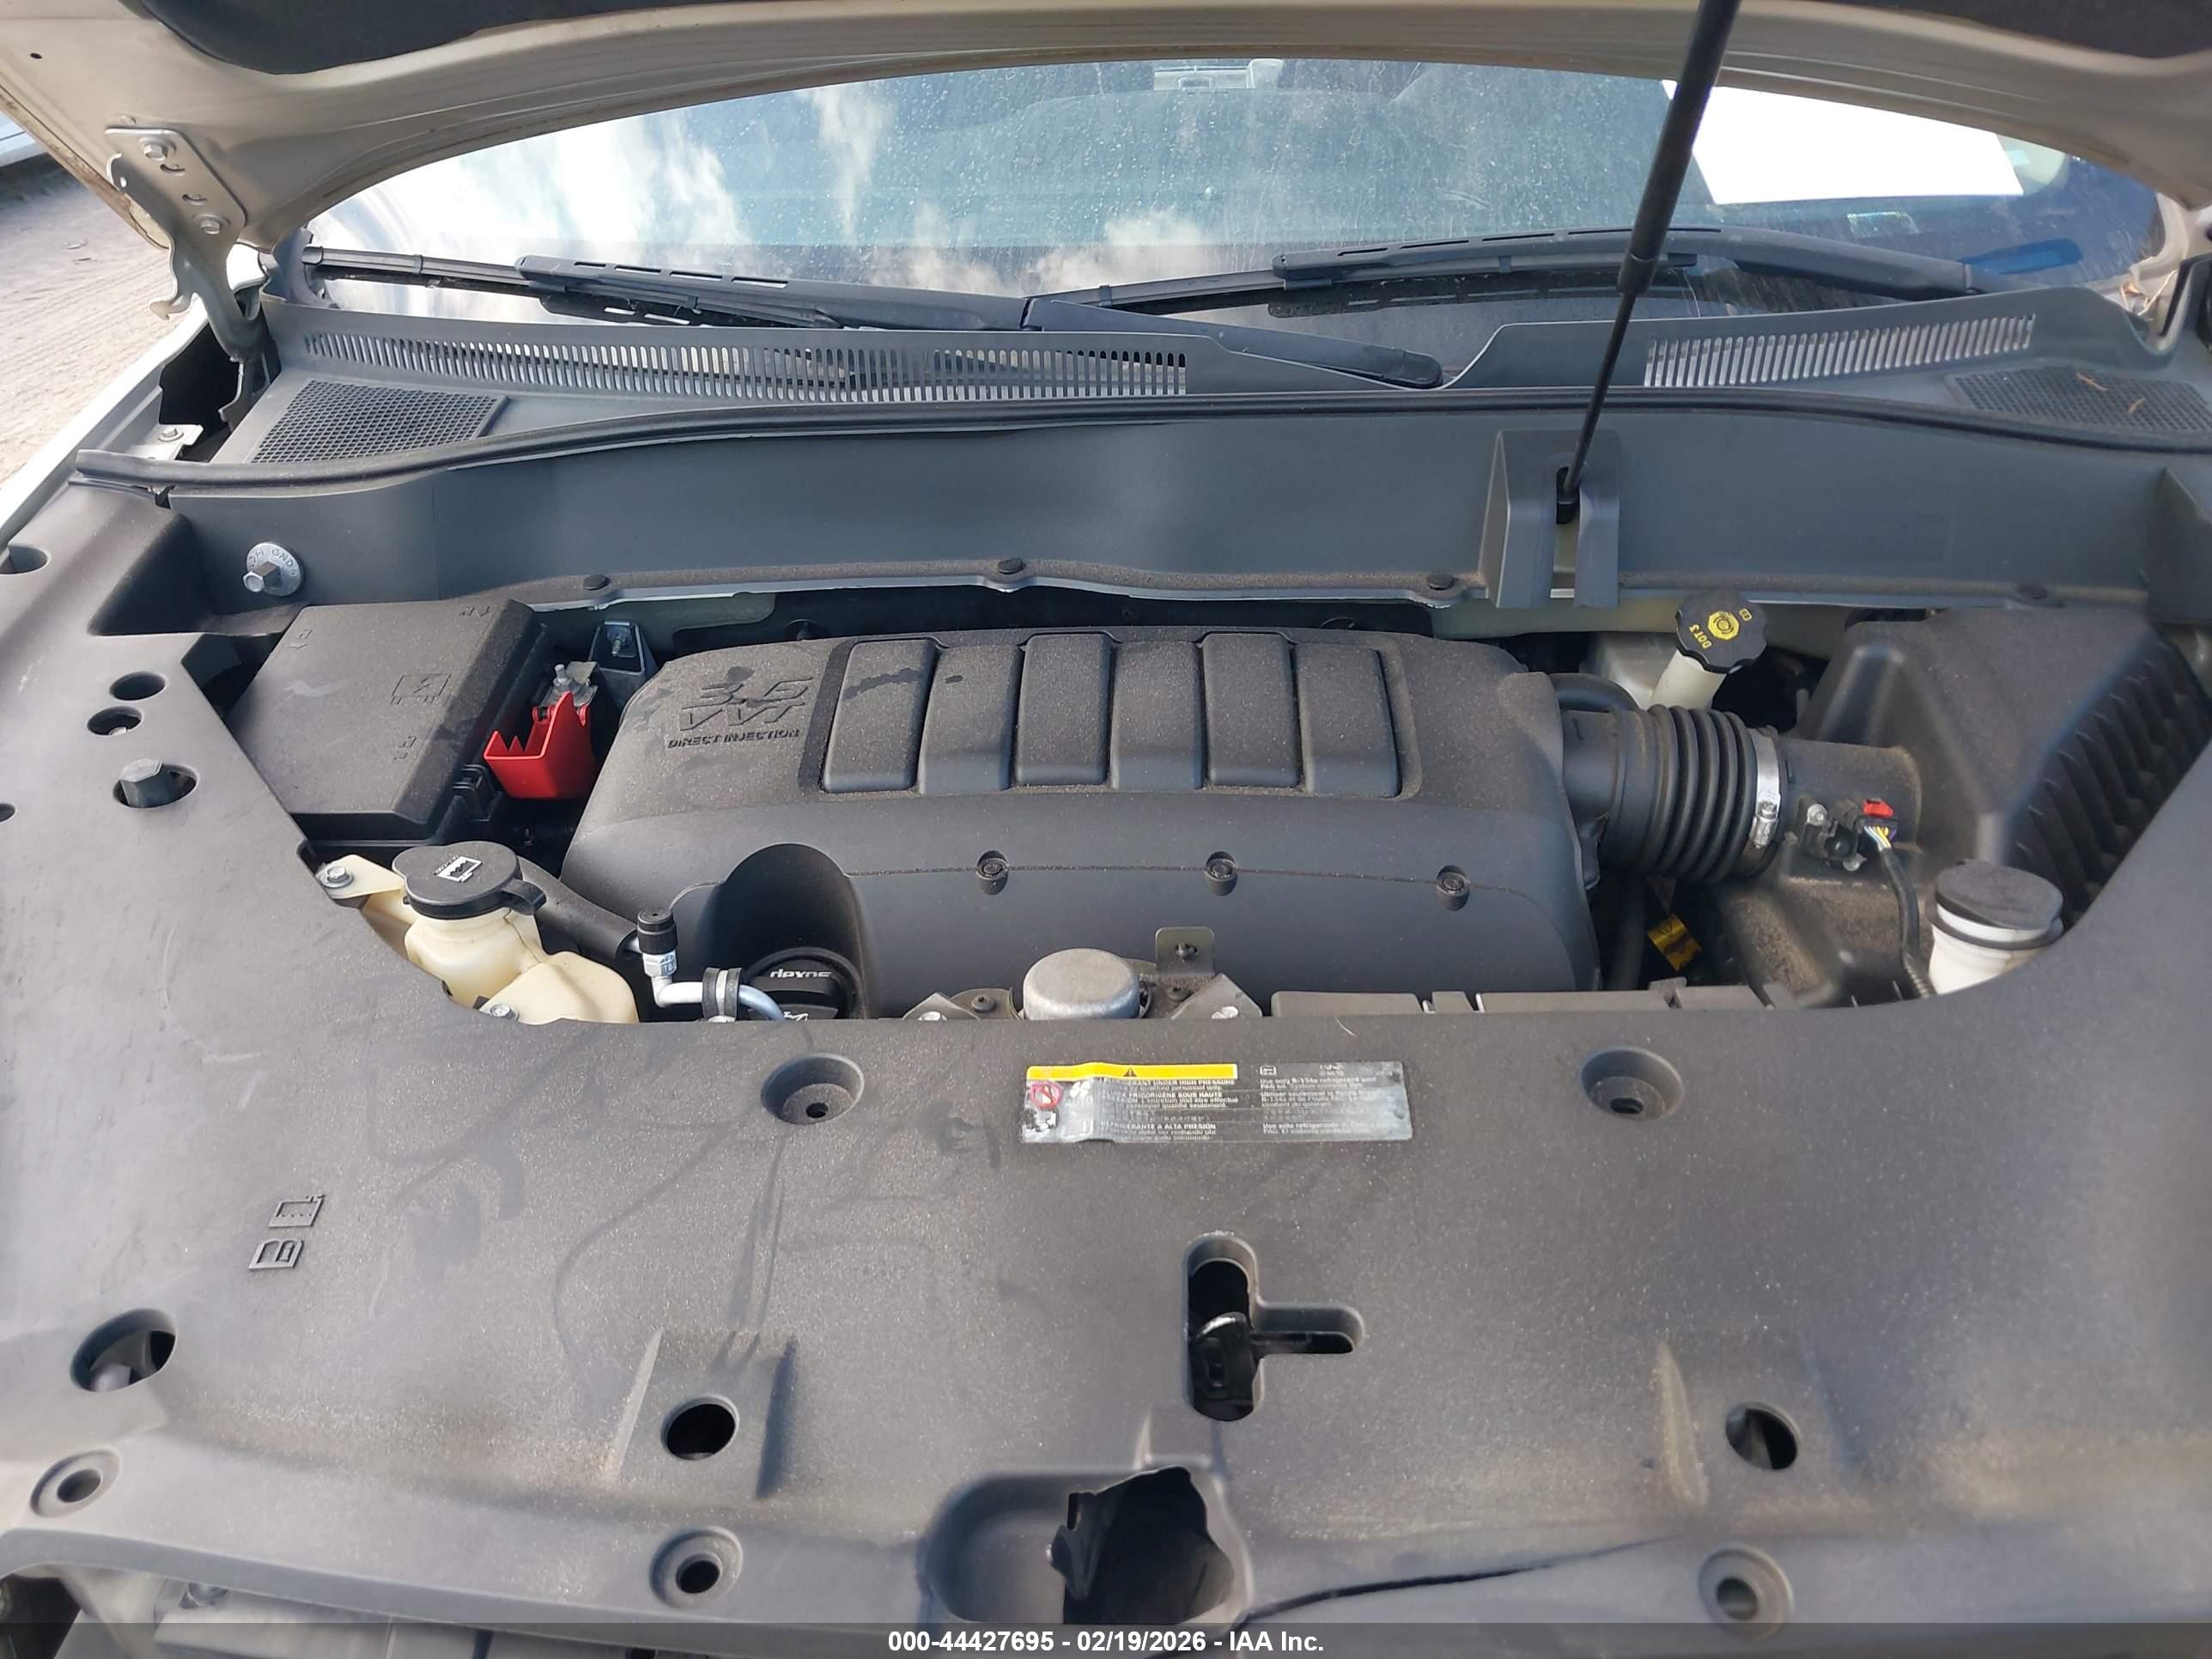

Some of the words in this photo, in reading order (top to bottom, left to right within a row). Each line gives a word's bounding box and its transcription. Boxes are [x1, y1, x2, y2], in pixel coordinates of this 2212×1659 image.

[681, 677, 813, 710] 3.6
[678, 702, 805, 732] VVT
[667, 734, 722, 749] DIRECT
[723, 729, 800, 743] INJECTION
